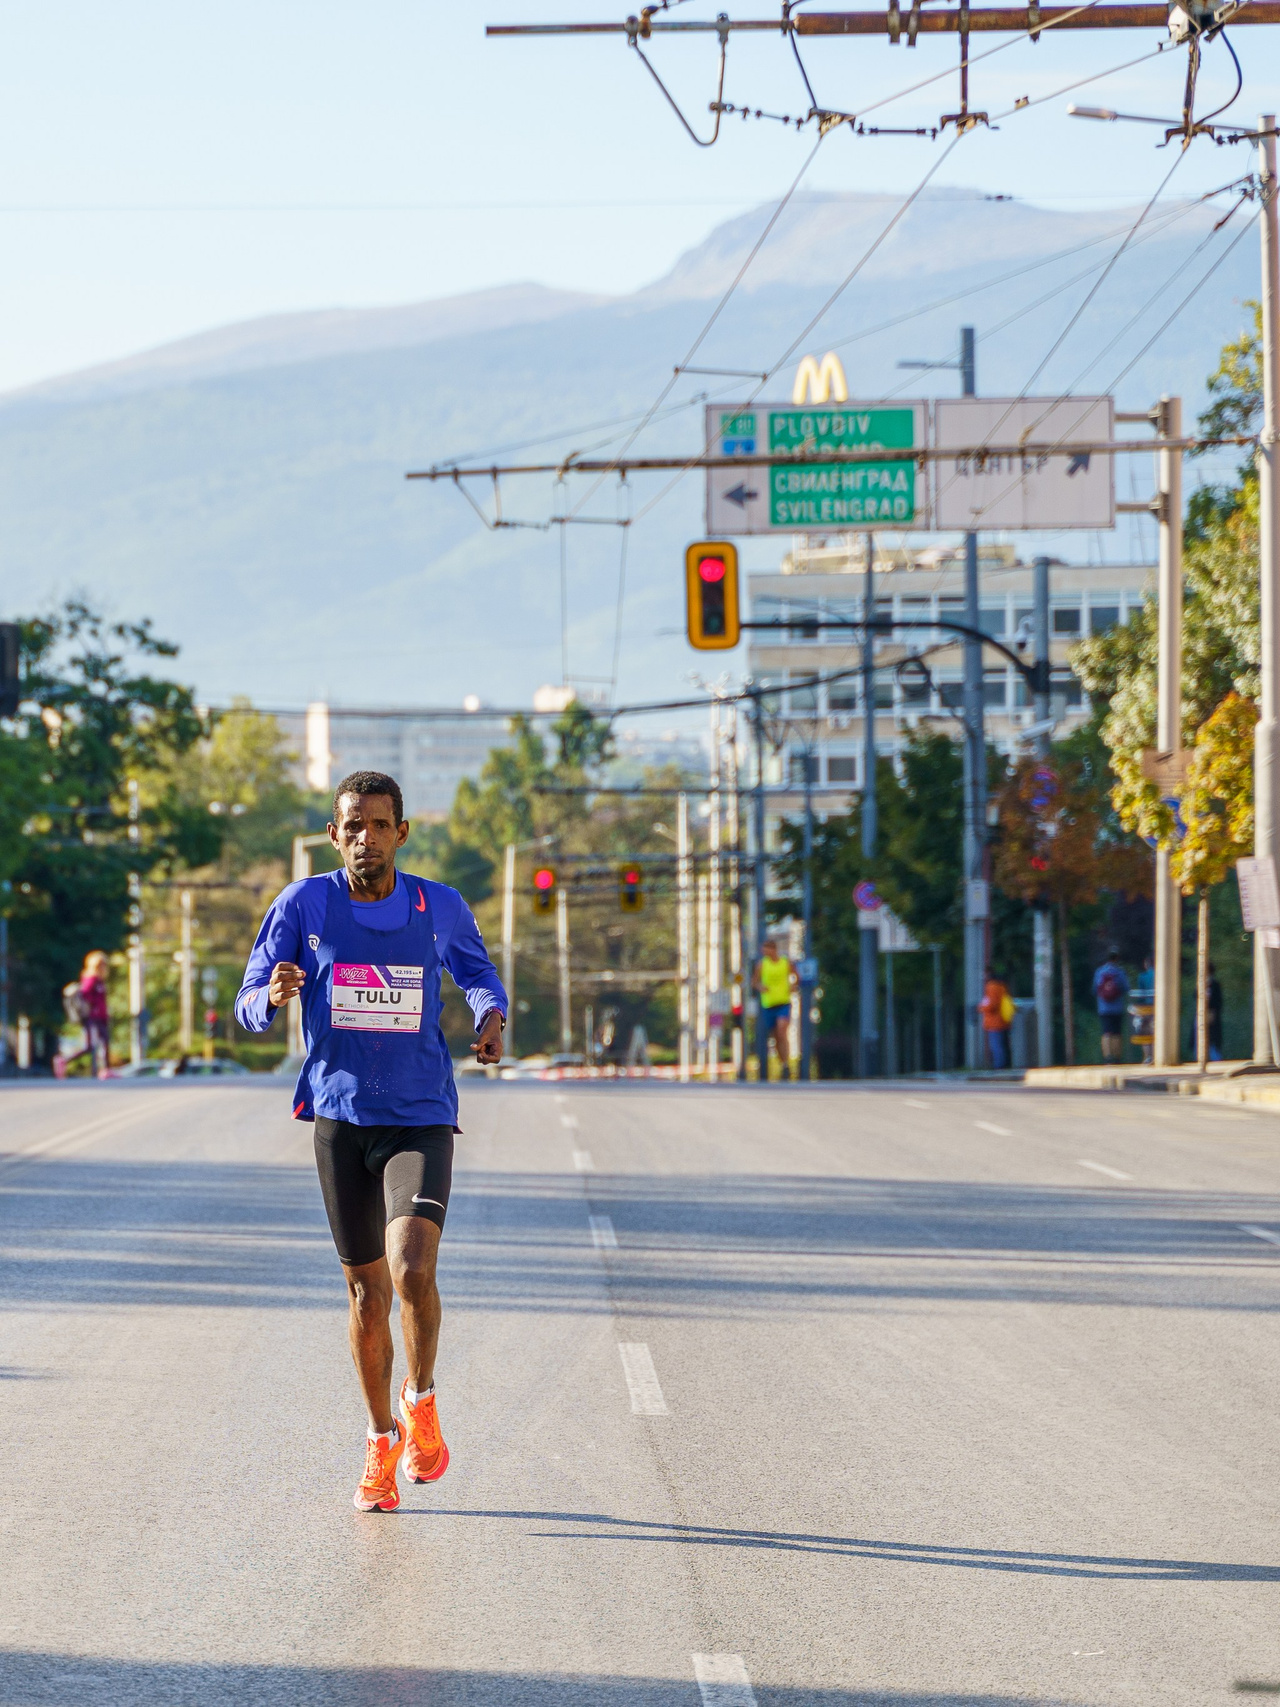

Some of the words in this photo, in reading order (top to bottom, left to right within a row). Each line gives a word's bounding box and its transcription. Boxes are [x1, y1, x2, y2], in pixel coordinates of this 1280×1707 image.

[773, 413, 872, 438] PLOVDIV
[774, 467, 909, 494] СВИЛЕНГРАД
[775, 496, 910, 523] SVILENGRAD
[354, 990, 402, 1004] TULU
